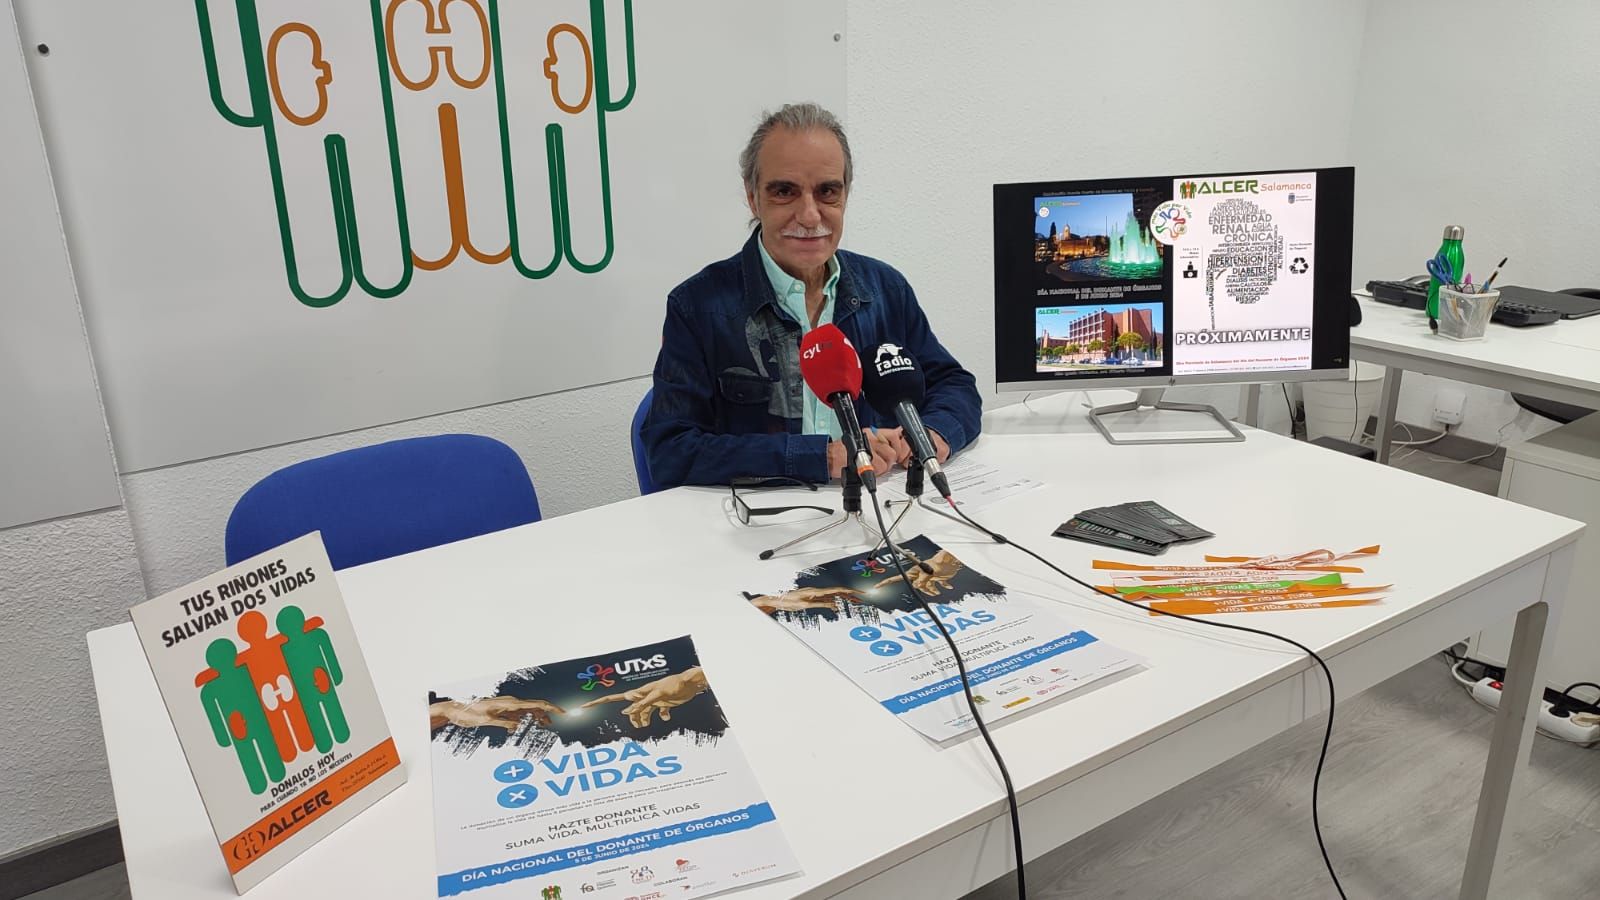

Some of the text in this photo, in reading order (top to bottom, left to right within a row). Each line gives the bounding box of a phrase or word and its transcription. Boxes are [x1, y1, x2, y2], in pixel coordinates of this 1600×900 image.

[1198, 180, 1312, 194] ALCER Salamanca
[1208, 214, 1272, 225] ENFERMEDAD
[1212, 224, 1250, 234] RENAL
[1224, 232, 1274, 242] CRONICA
[1208, 256, 1264, 266] HIPERTENSION
[1176, 328, 1311, 345] PRÓXIMAMENTE
[876, 356, 912, 371] radio
[180, 558, 288, 618] TUS RIÑONES
[161, 567, 316, 648] SALVAN DOS VIDAS
[882, 604, 960, 632] VIDA
[898, 610, 996, 645] VIDAS
[614, 654, 668, 675] UTxS
[910, 670, 936, 682] SUMA
[1010, 635, 1035, 647] VIDAS
[933, 651, 958, 667] HAZT
[961, 640, 1002, 657] DONANTE
[900, 694, 917, 706] DÍA
[917, 678, 963, 699] NACIONAL
[982, 656, 1024, 674] DONANTE
[1024, 652, 1037, 660] DE
[1036, 636, 1078, 655] ÓRGANOS
[270, 764, 315, 798] DONALOS
[317, 751, 336, 770] HOY
[541, 741, 650, 775] VIDA
[260, 802, 276, 813] PARA
[276, 787, 298, 803] CUANDO
[318, 768, 327, 777] LOS
[544, 755, 683, 798] VIDAS
[268, 790, 332, 841] ALCER
[505, 834, 544, 851] SUMA
[586, 812, 660, 833] MULTIPLICA
[663, 802, 700, 816] VIDAS
[548, 803, 658, 833] HAZTE DONANTE
[462, 812, 750, 883] DÍA NACIONAL DEL DONANTE DE ÓRGANOS
